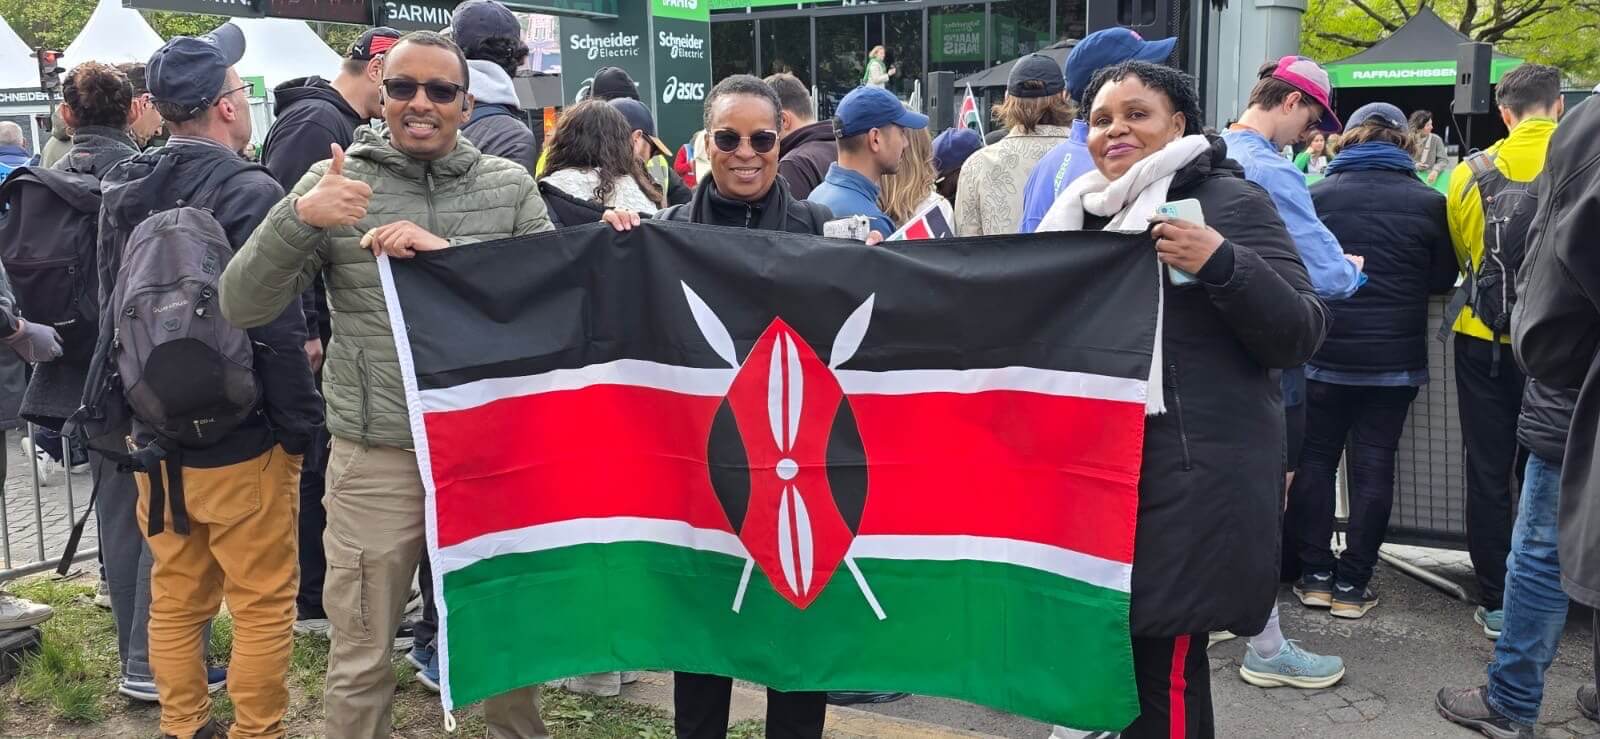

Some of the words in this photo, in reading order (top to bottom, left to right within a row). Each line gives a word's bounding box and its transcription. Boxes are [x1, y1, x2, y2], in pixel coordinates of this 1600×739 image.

[569, 32, 639, 50] Schneider
[659, 31, 704, 49] Schneider
[600, 48, 639, 58] Electric
[679, 48, 704, 59] Electric
